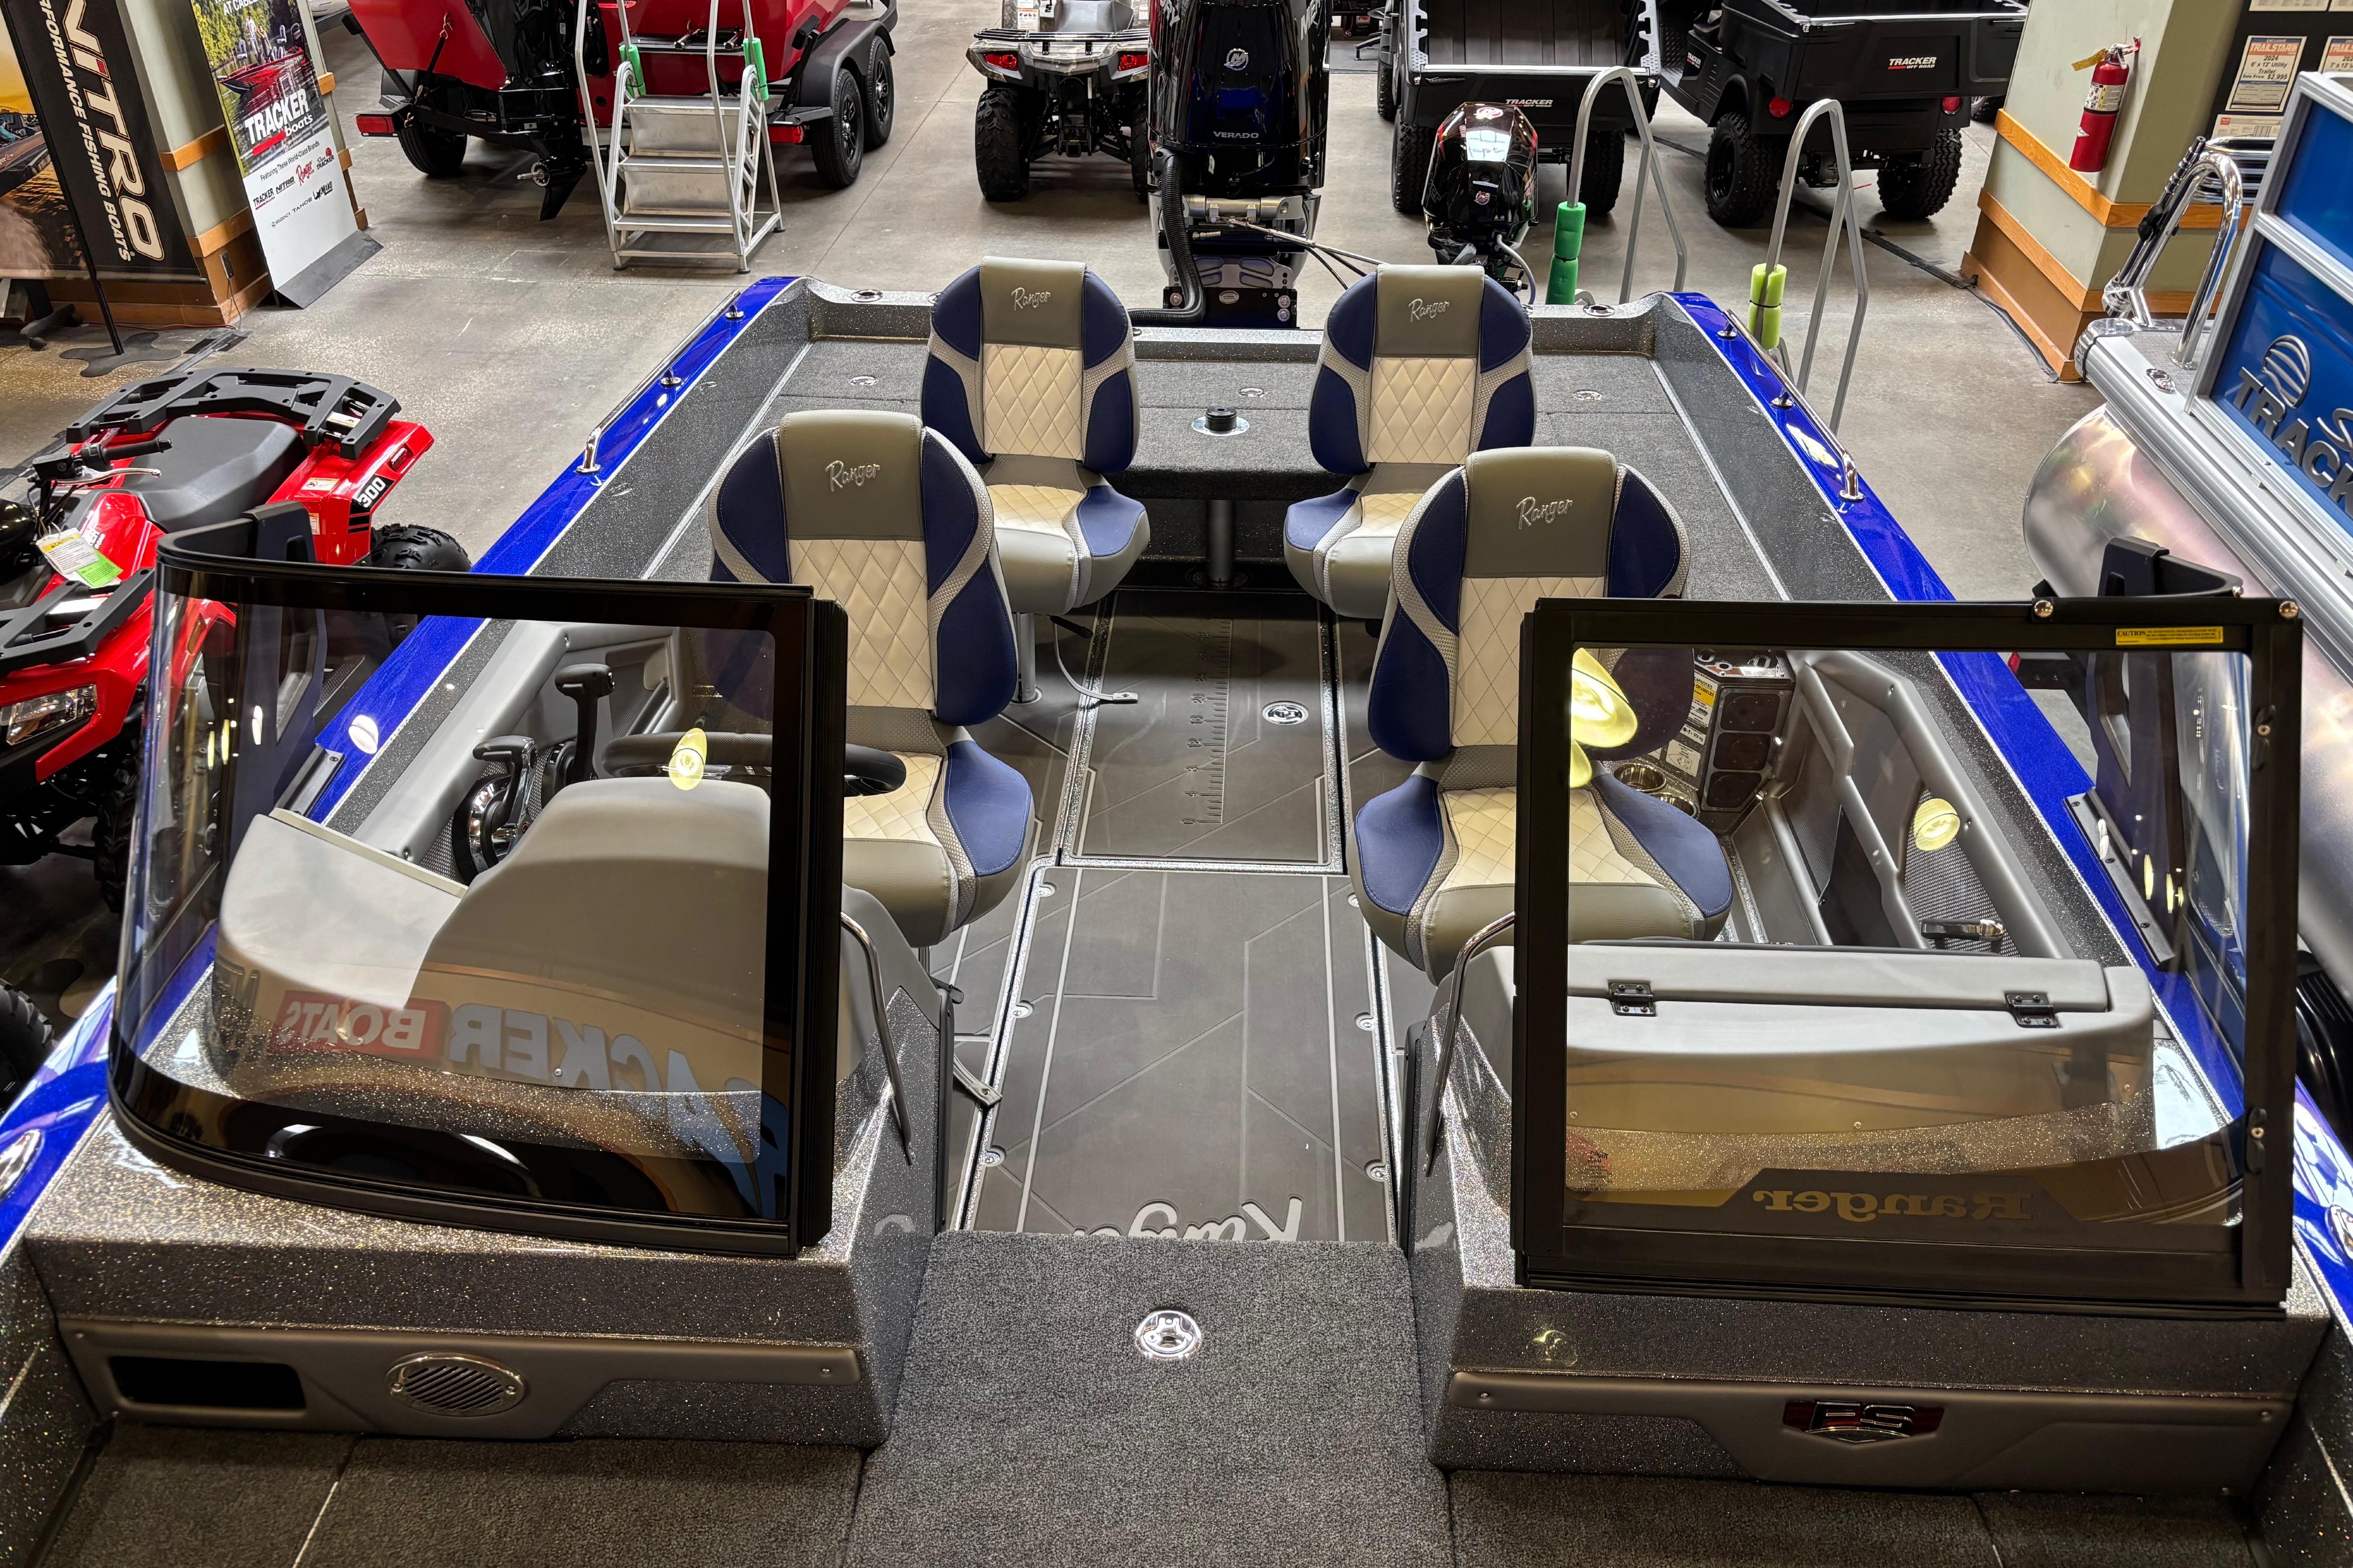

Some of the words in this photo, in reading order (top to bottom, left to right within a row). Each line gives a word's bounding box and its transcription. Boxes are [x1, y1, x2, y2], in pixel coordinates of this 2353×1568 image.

[223, 1, 232, 16] AT
[1889, 57, 1937, 66] TRACKER
[244, 89, 310, 144] TRACKER
[285, 113, 313, 137] boats
[78, 121, 111, 197] FISHING
[260, 168, 278, 181] Featuring
[278, 162, 288, 171] These
[307, 140, 320, 152] Brands
[316, 156, 334, 170] TRACKER
[276, 176, 295, 193] NITRO
[296, 160, 312, 186] Ranger
[253, 188, 274, 206] TRACKER
[276, 212, 291, 224] REGENCY
[292, 197, 312, 212] TAHOE
[1011, 287, 1051, 311] Ranger
[1408, 298, 1450, 322] Ranger
[824, 460, 880, 492] Ranger
[357, 477, 386, 508] 300
[1516, 496, 1573, 529] Ranger
[54, 537, 74, 547] CAUTION
[1191, 693, 1206, 703] 20
[1187, 738, 1202, 747] 12
